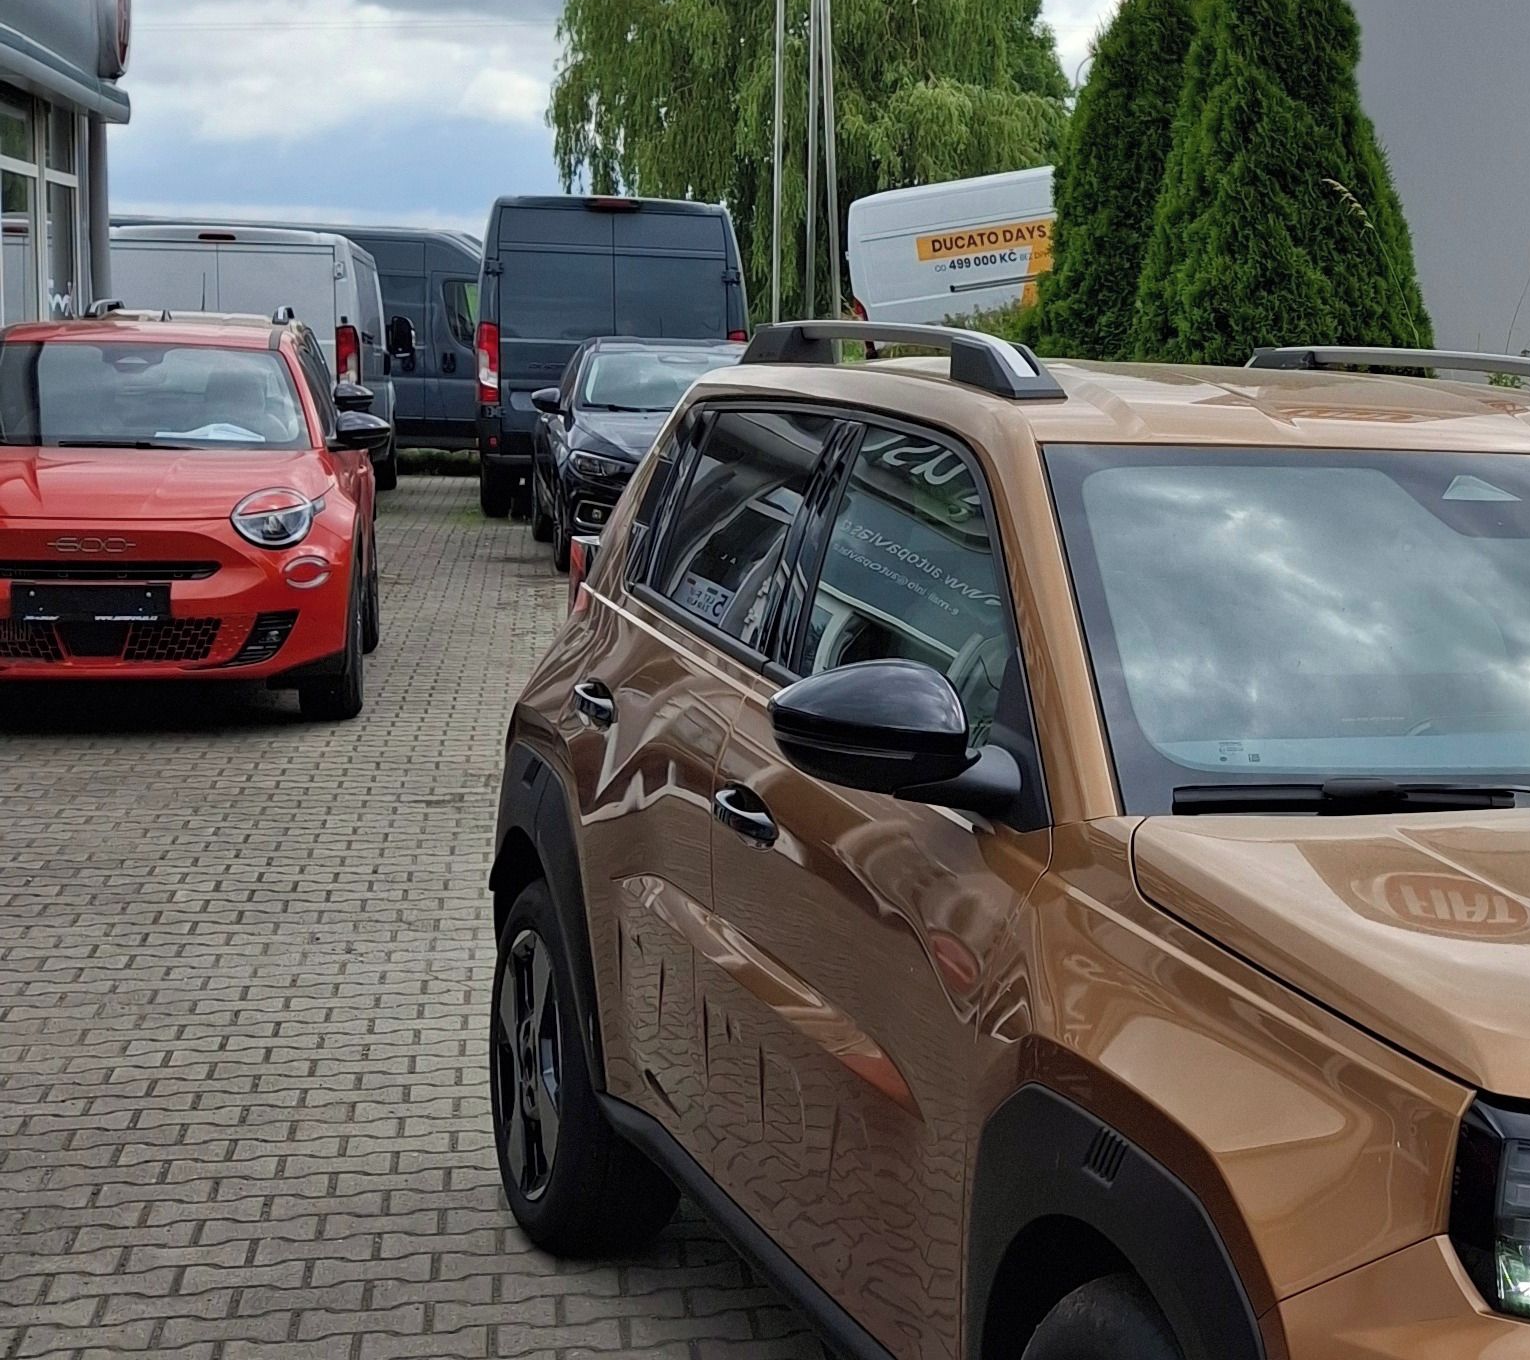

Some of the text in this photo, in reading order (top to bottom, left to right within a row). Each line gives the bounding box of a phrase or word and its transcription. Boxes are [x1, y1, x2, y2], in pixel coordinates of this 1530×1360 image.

[931, 224, 1047, 253] DUCATO DAYS
[949, 257, 971, 271] 499
[973, 254, 997, 267] 000
[55, 537, 128, 553] 600
